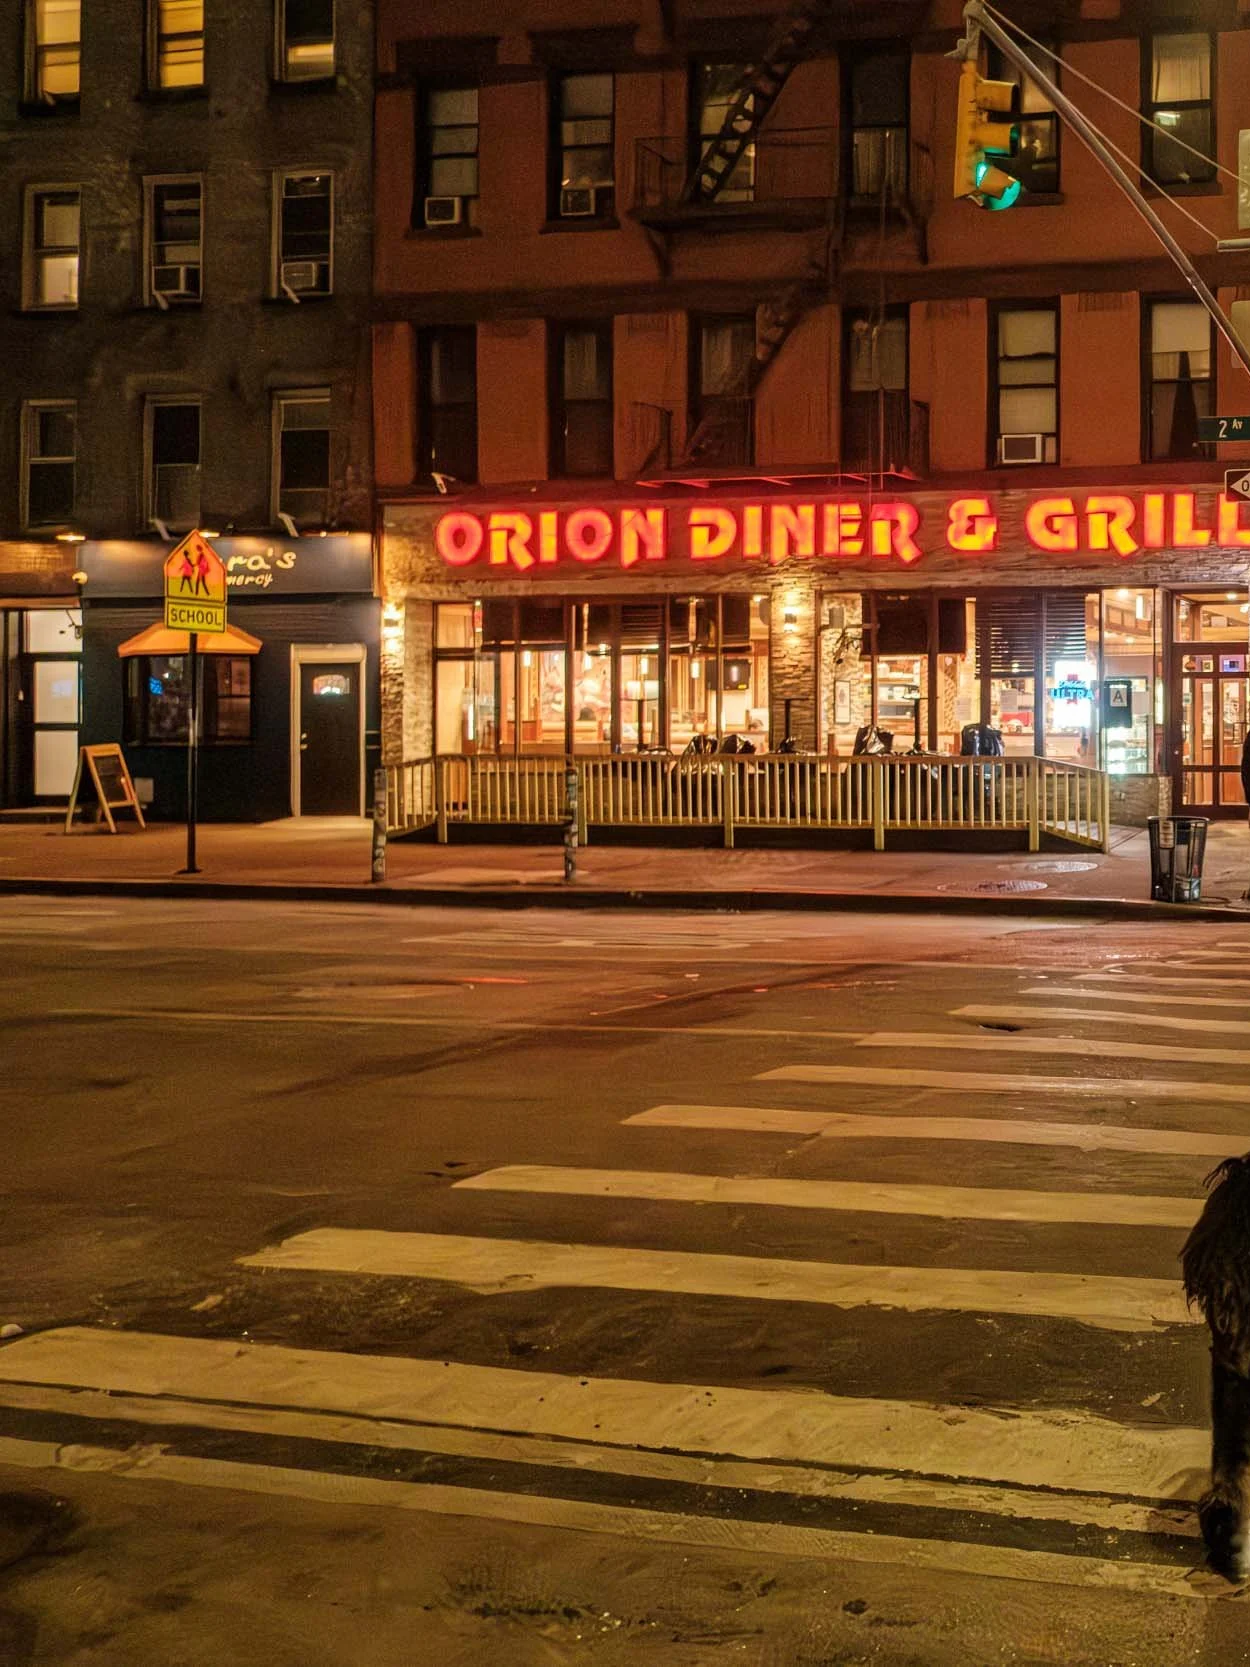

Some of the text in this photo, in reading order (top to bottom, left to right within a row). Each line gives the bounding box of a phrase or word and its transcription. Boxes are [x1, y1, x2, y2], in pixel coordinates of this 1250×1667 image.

[1218, 420, 1228, 438] 2
[436, 508, 665, 569] ORION
[687, 502, 923, 565] DINER
[946, 497, 998, 551] &
[169, 607, 222, 627] SCHOOL
[1050, 687, 1095, 702] ULTRA
[1112, 690, 1124, 703] A
